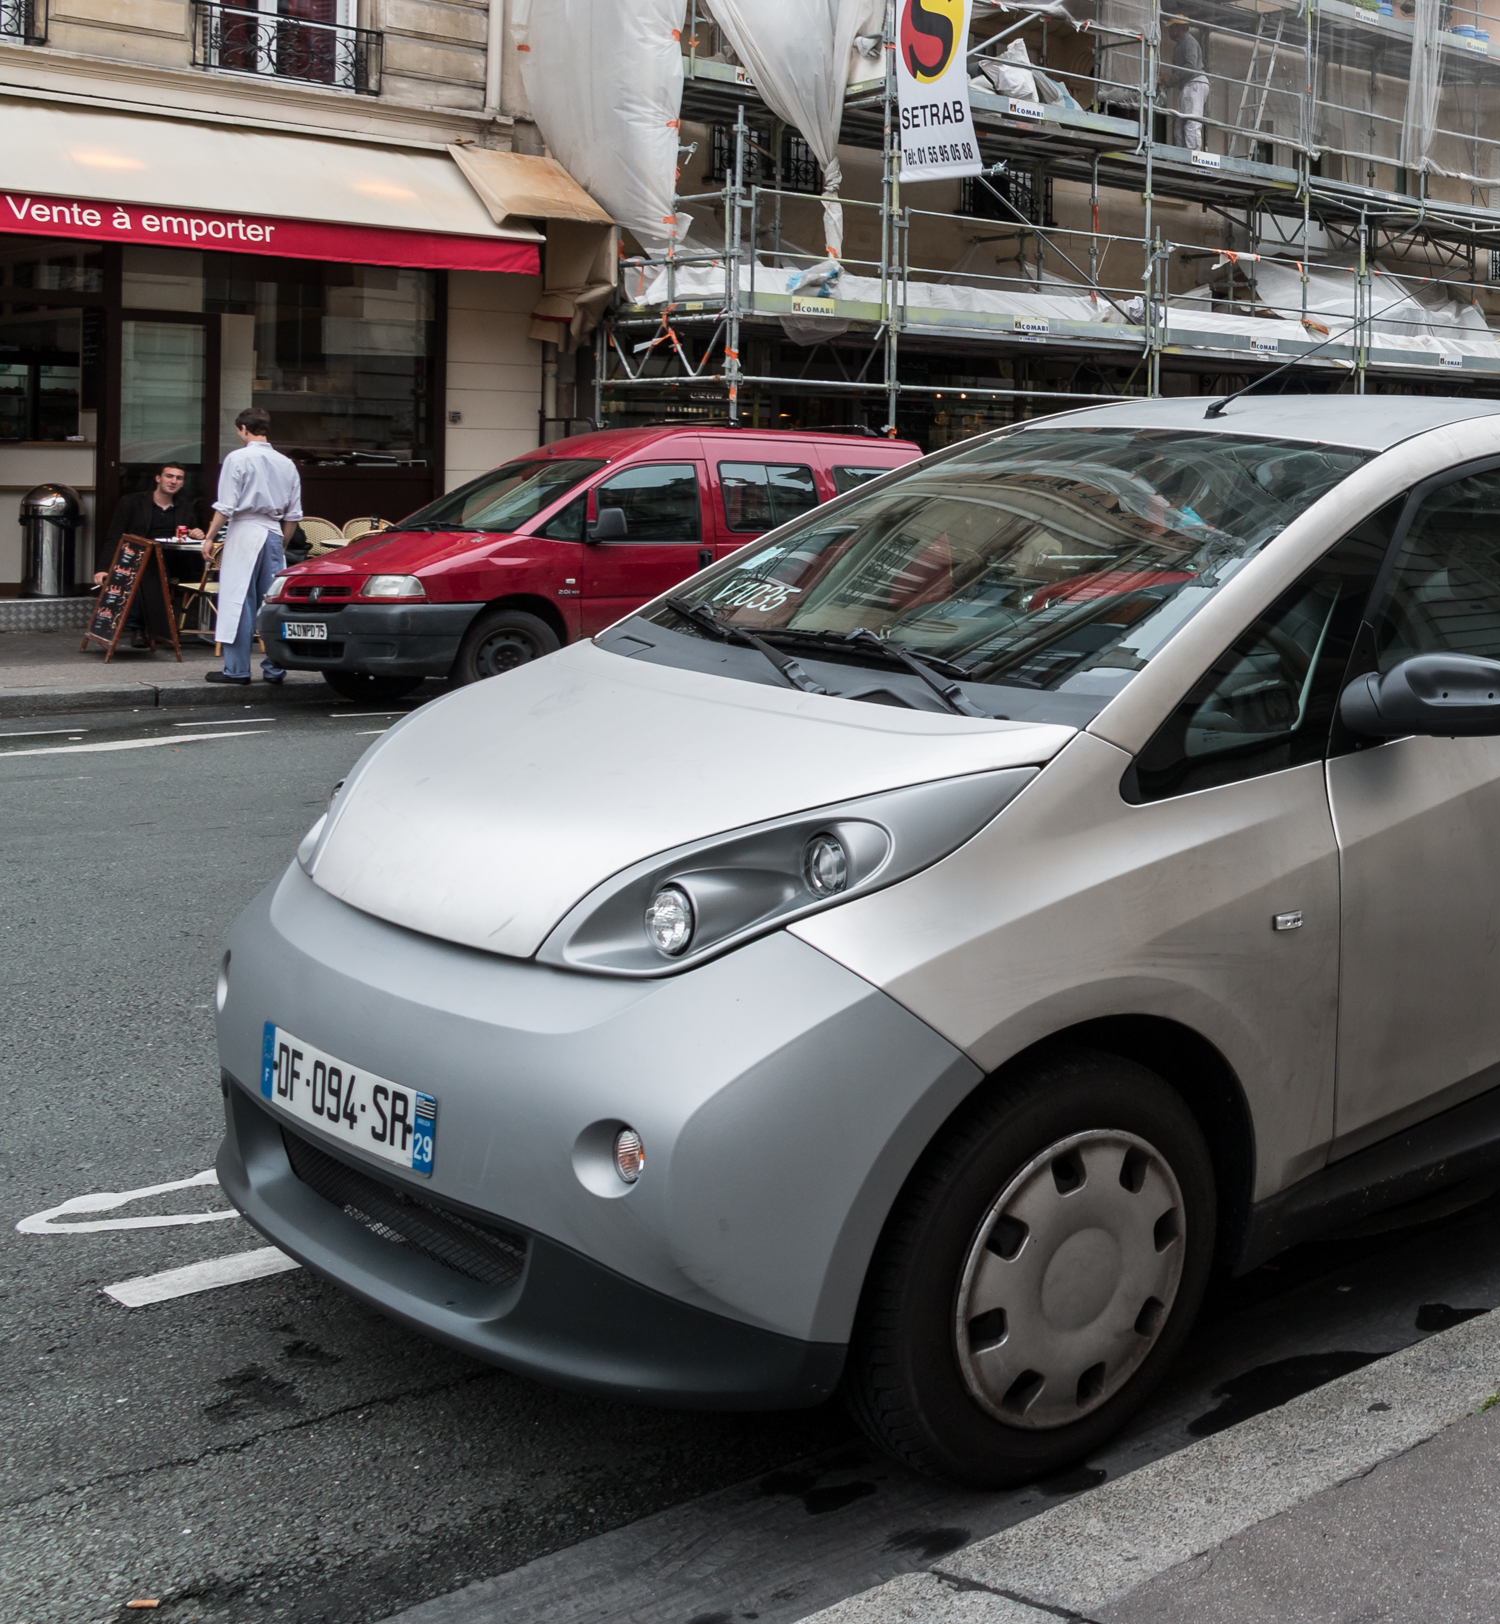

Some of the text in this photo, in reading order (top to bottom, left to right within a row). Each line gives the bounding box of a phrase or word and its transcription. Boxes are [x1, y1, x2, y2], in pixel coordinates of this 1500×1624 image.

[902, 100, 965, 130] SETRAB
[1017, 107, 1043, 118] COMABI
[918, 147, 928, 165] 01
[928, 146, 938, 163] 55
[939, 144, 950, 162] 95
[950, 143, 962, 161] 05
[962, 142, 974, 160] 88
[1198, 159, 1220, 167] COMABI
[5, 195, 276, 243] Vente à emporter
[802, 306, 833, 314] COMABI
[712, 580, 802, 612] V1035
[413, 1132, 432, 1163] 29
